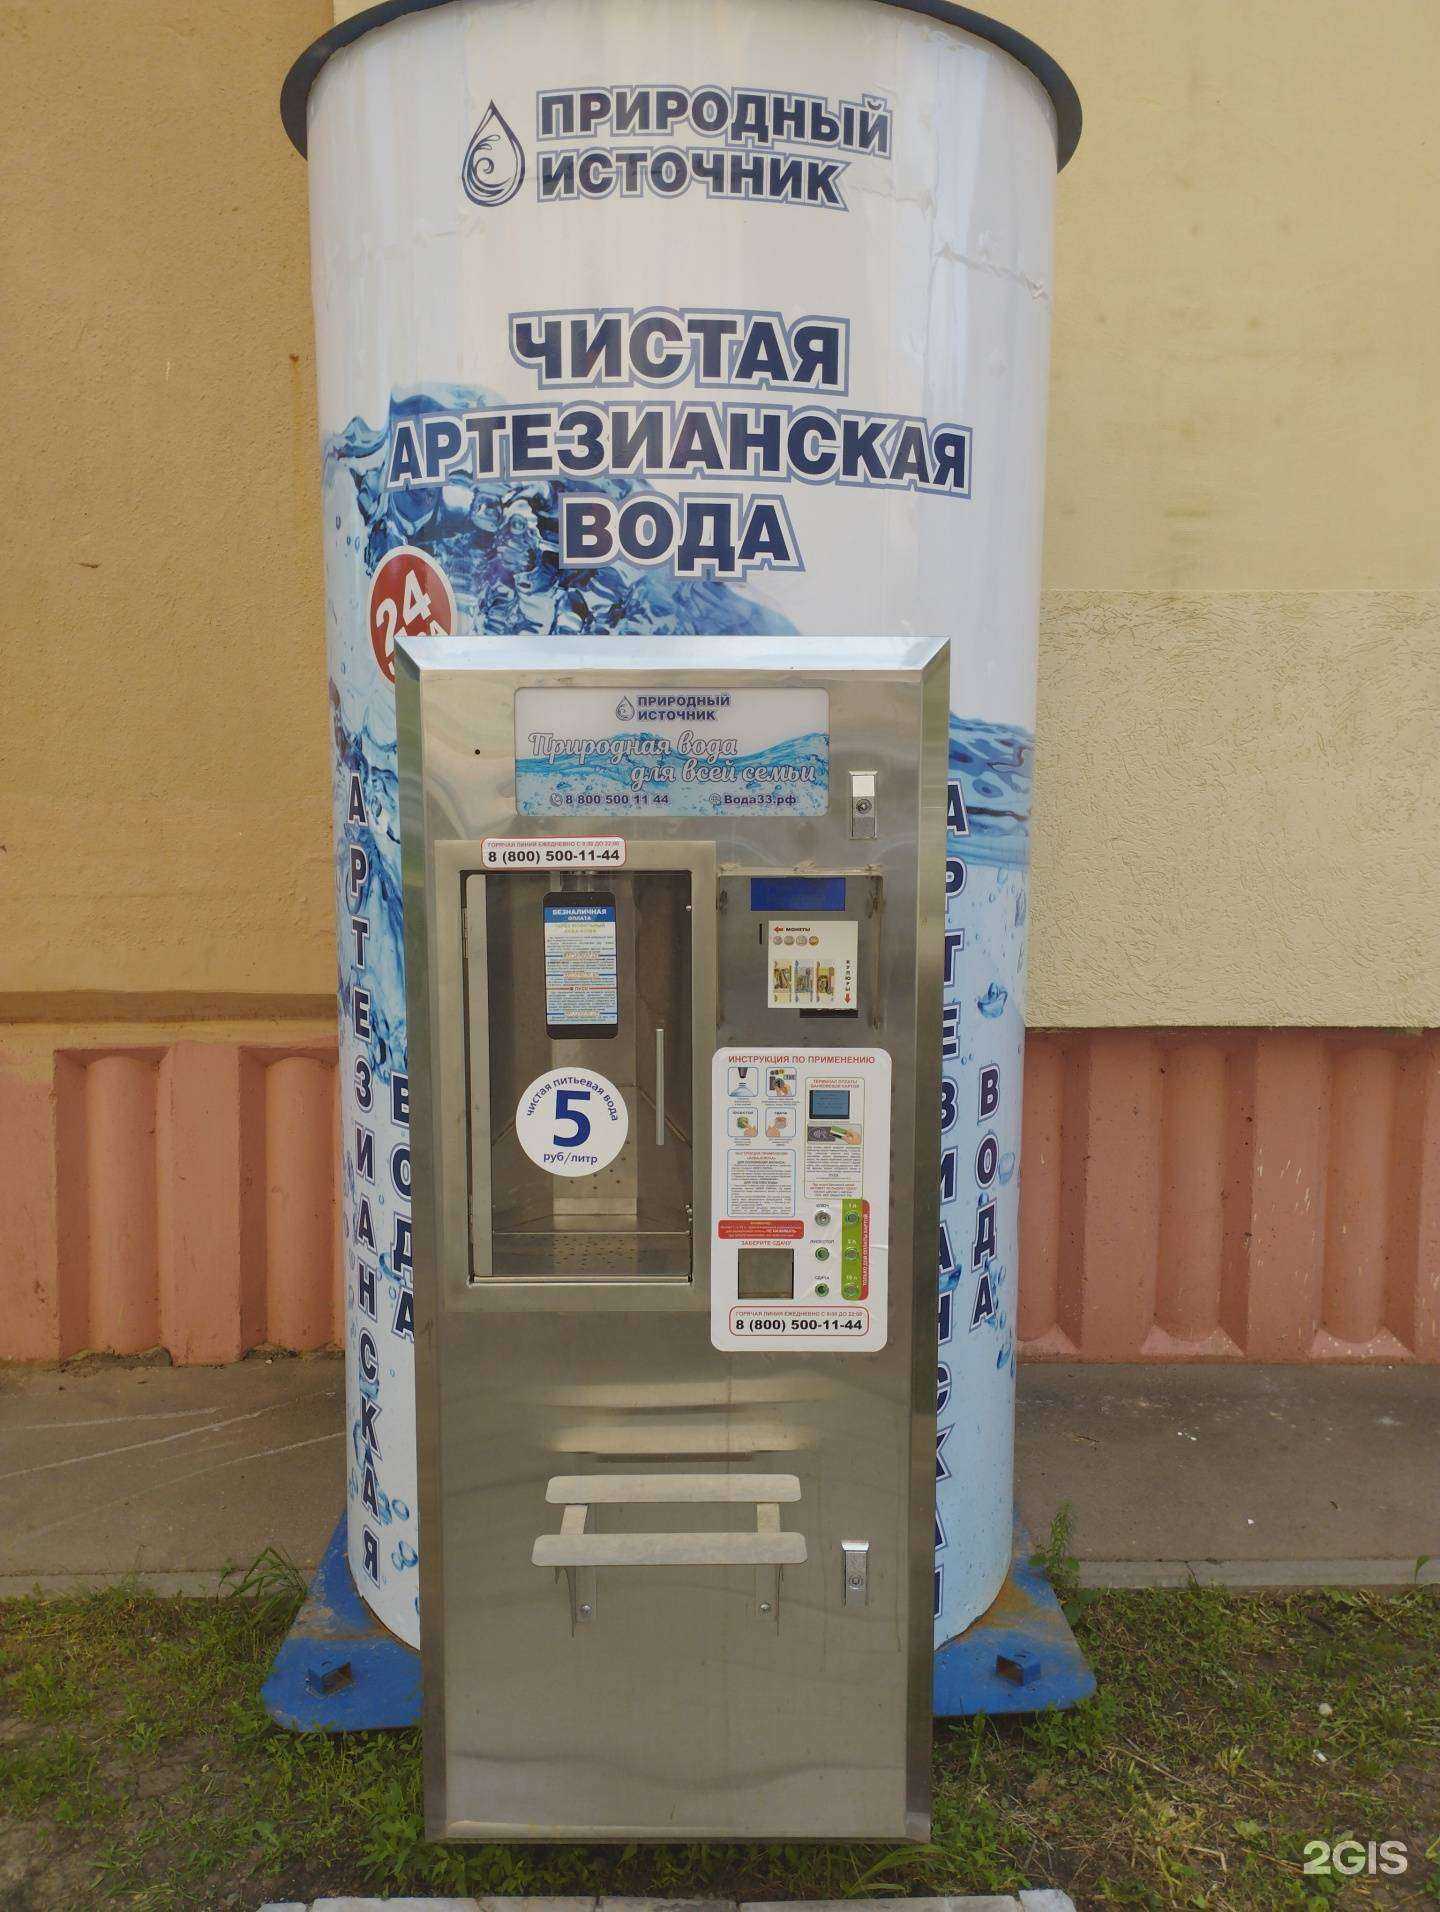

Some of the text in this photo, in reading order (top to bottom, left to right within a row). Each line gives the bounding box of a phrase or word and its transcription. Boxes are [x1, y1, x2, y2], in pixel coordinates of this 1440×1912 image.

[539, 88, 890, 156] ПРИРОДНЫЙ
[540, 151, 843, 206] ИСТОЧНИК
[513, 315, 843, 388] ЧИСТАЯ
[388, 409, 967, 491] АРТЕЗИАНСКАЯ
[563, 499, 792, 573] ВОДА
[638, 693, 730, 707] ПРИРОДНЫЙ
[638, 710, 716, 721] ИСТОЧНИК
[528, 730, 738, 765] Природная вода
[631, 758, 817, 791] для всей семьи
[565, 794, 669, 804] 8 800 500 11 44
[724, 794, 797, 806] Вода33.рф
[488, 849, 620, 864] 8 (800) 500-11-44
[728, 1055, 876, 1064] ИНСТРУКЦИЯ ПО ПРИМЕНЕНИЮ
[526, 1076, 618, 1121] чистая питьевая вода
[553, 1090, 591, 1147] 5
[543, 1152, 598, 1165] руб/литр
[348, 774, 380, 1584] АРТЕЗИАНСКАЯ
[973, 1066, 1000, 1328] ВОДА
[735, 1319, 863, 1332] 8 (800) 500-11-44
